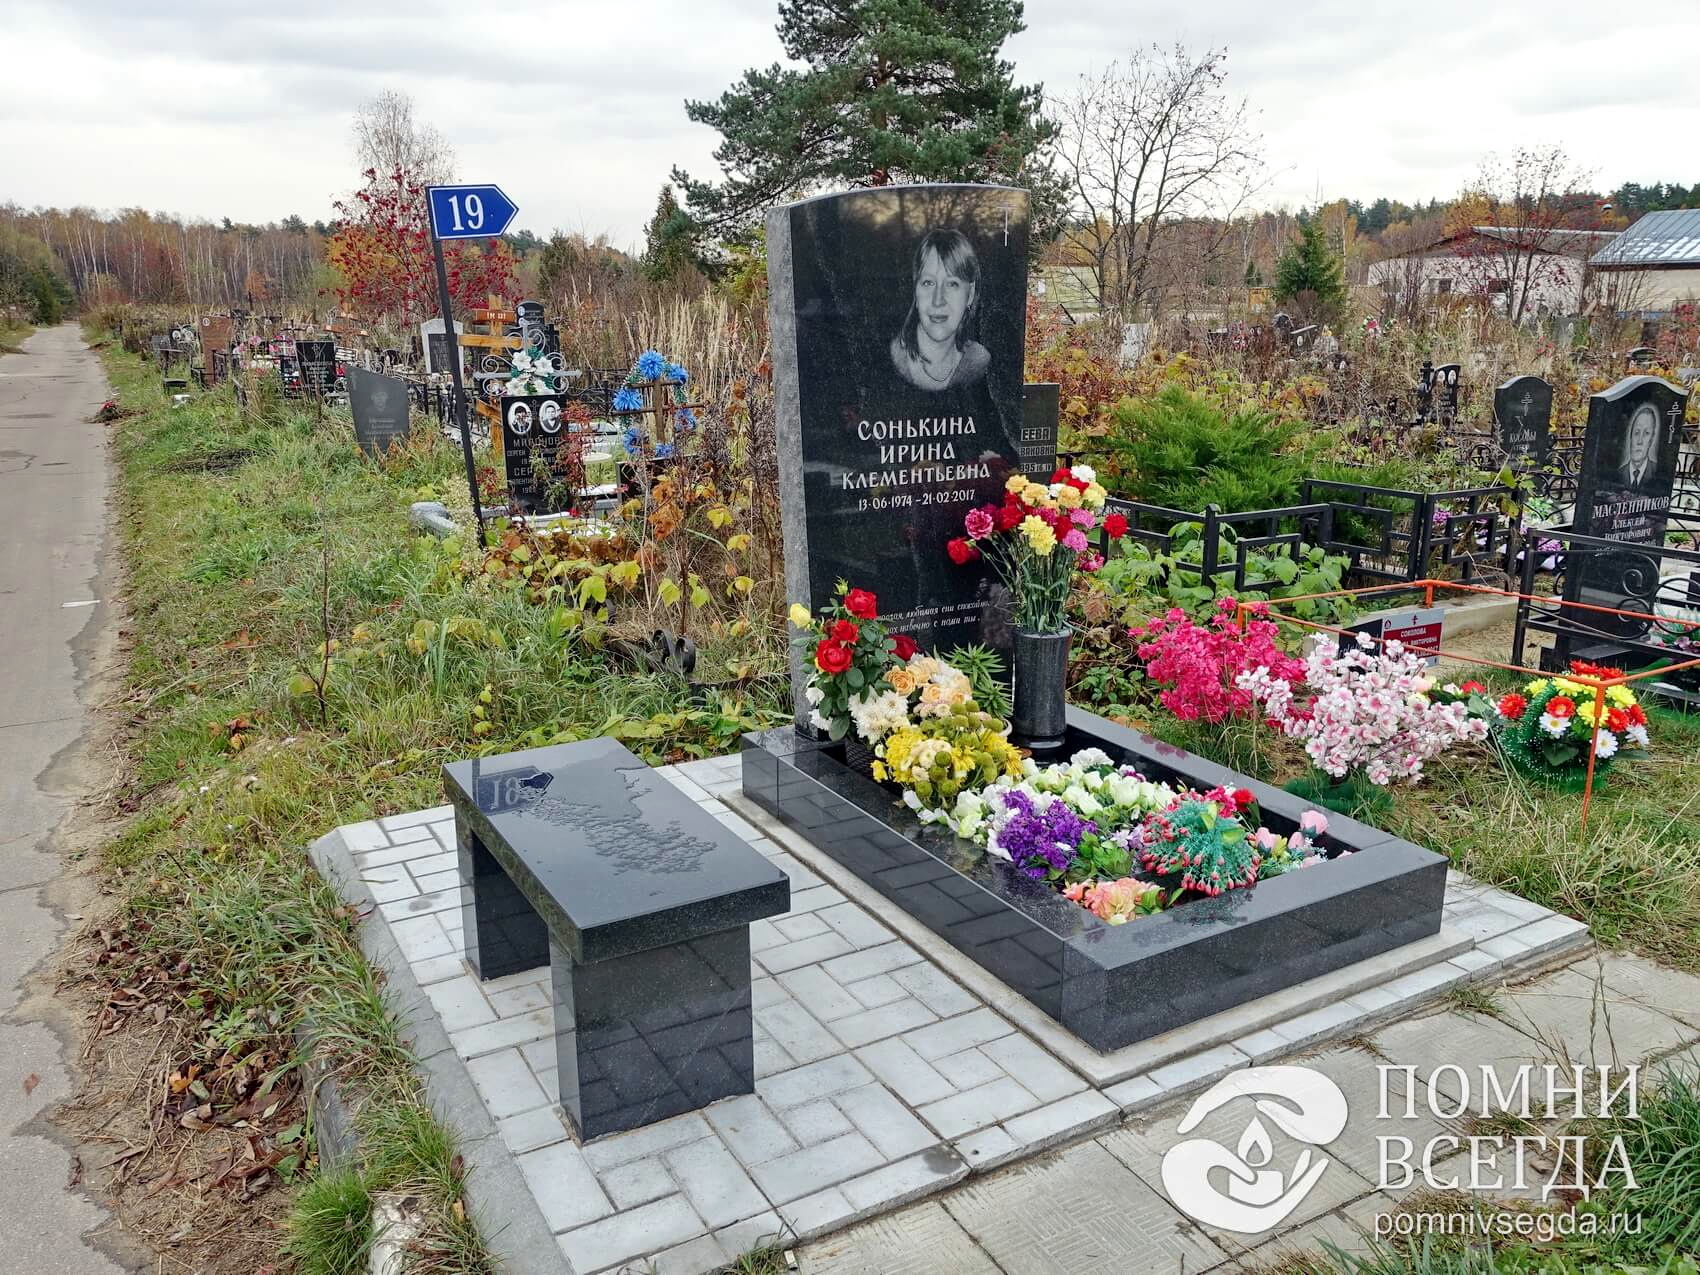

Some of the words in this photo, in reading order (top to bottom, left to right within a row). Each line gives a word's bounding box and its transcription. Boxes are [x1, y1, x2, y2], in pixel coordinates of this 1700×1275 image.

[448, 194, 484, 231] 19
[857, 416, 977, 441] СОНЬКИНА
[880, 442, 956, 465] ИРИНА
[842, 463, 991, 490] КЛЕМЕНТЬЕВНА
[1592, 496, 1669, 519] МАСЛЕННИКОВ
[1611, 513, 1646, 530] АЛЕКСЕЙ
